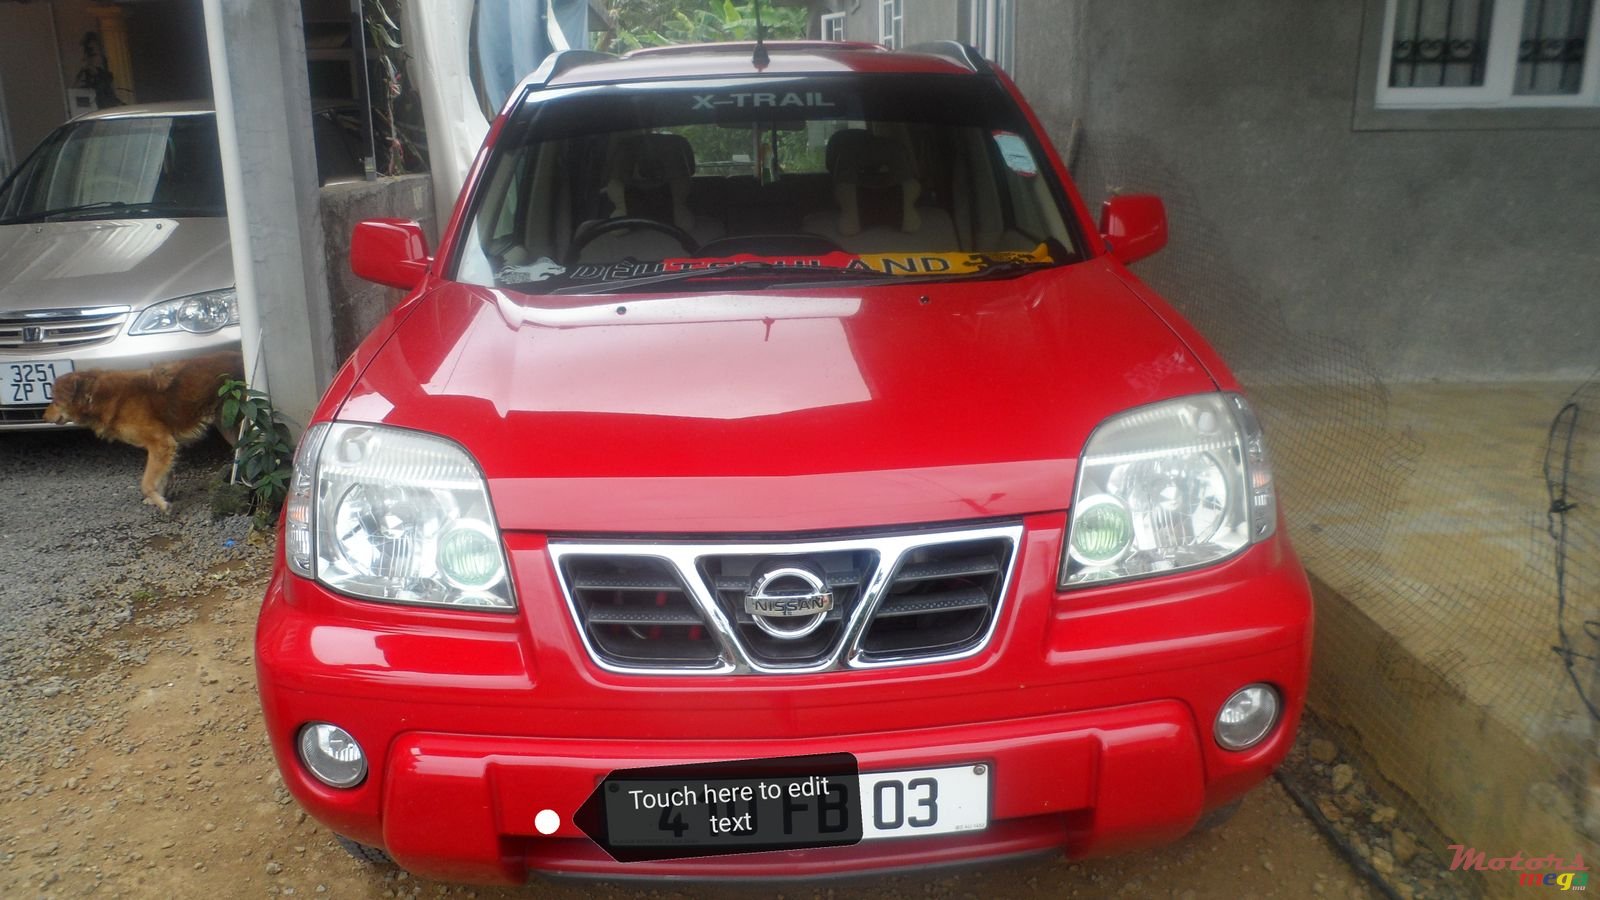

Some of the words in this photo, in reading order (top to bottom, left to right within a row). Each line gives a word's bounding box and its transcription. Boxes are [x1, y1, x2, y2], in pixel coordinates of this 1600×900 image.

[691, 92, 836, 110] X-TRAIL
[10, 363, 56, 382] 3251
[10, 383, 34, 401] ZP
[755, 598, 824, 612] NISSAN
[873, 777, 939, 831] 03
